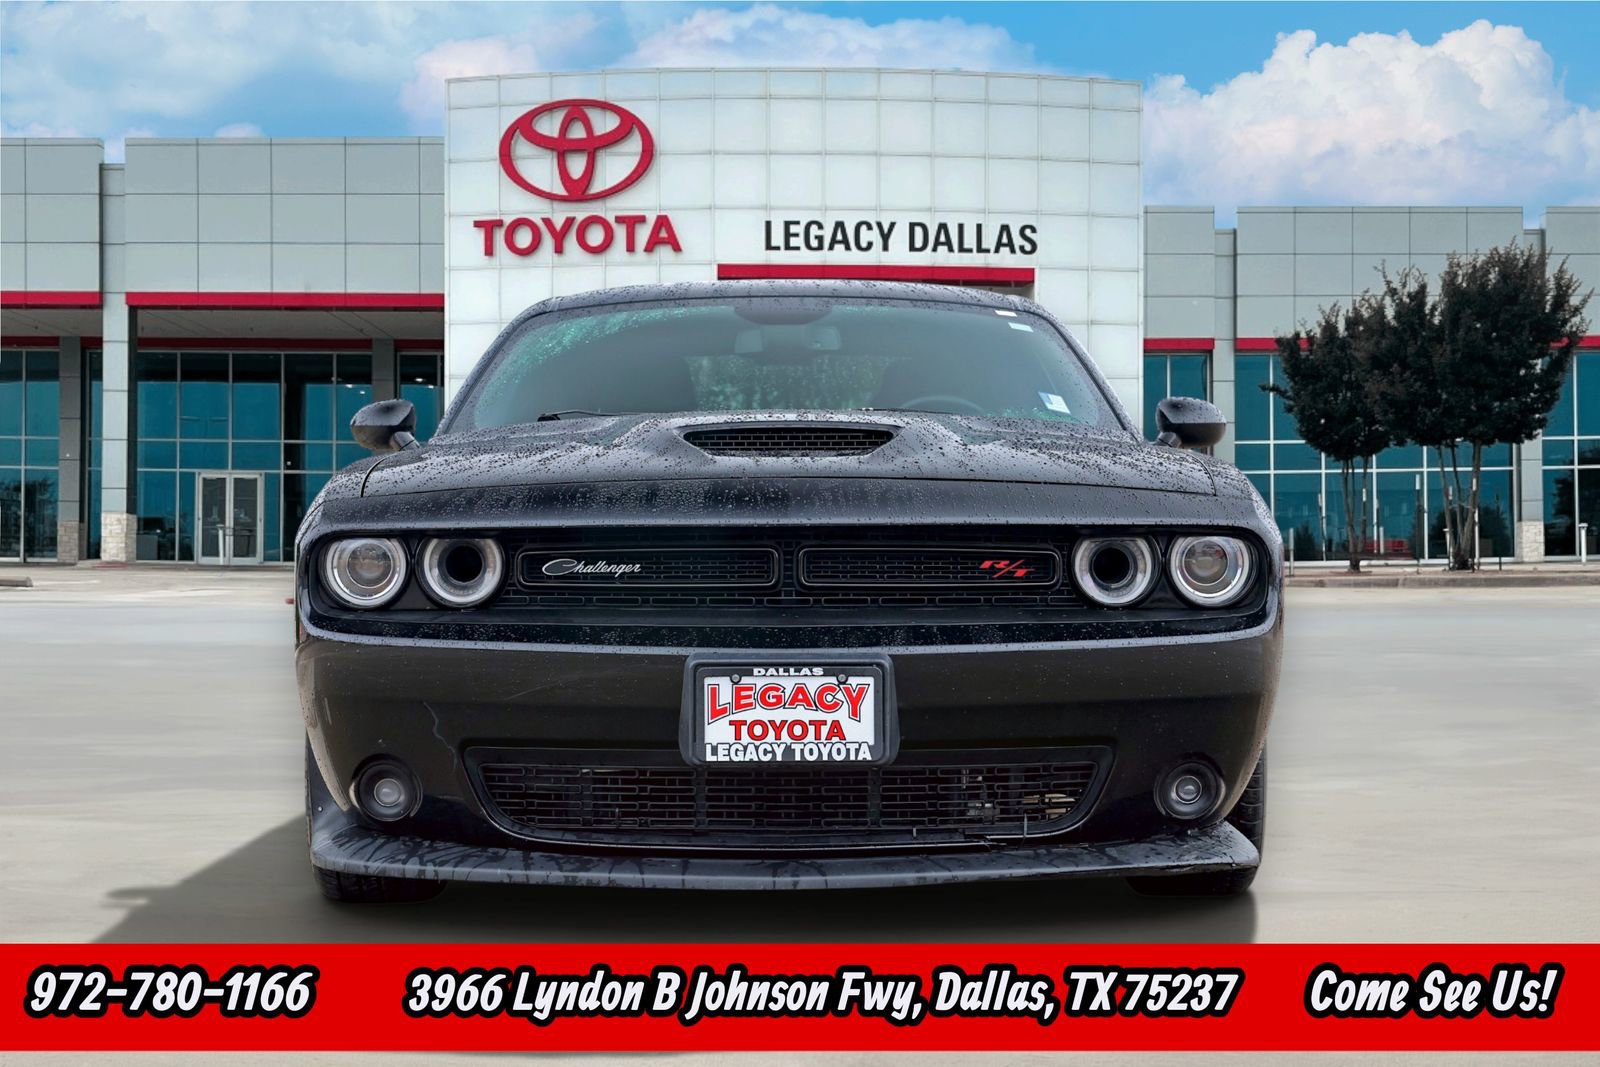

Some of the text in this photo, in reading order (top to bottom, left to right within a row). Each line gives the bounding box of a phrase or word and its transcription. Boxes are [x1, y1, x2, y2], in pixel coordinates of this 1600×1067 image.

[473, 213, 682, 257] TOYOTA
[764, 219, 1038, 256] LEGACY DALLAS
[542, 558, 642, 577] Challenger
[978, 559, 1037, 578] R/T
[753, 667, 824, 676] DALLAS
[707, 682, 871, 726] LEGACY
[728, 719, 847, 742] TOYOTA
[705, 742, 872, 762] LEGACY TOYOTA
